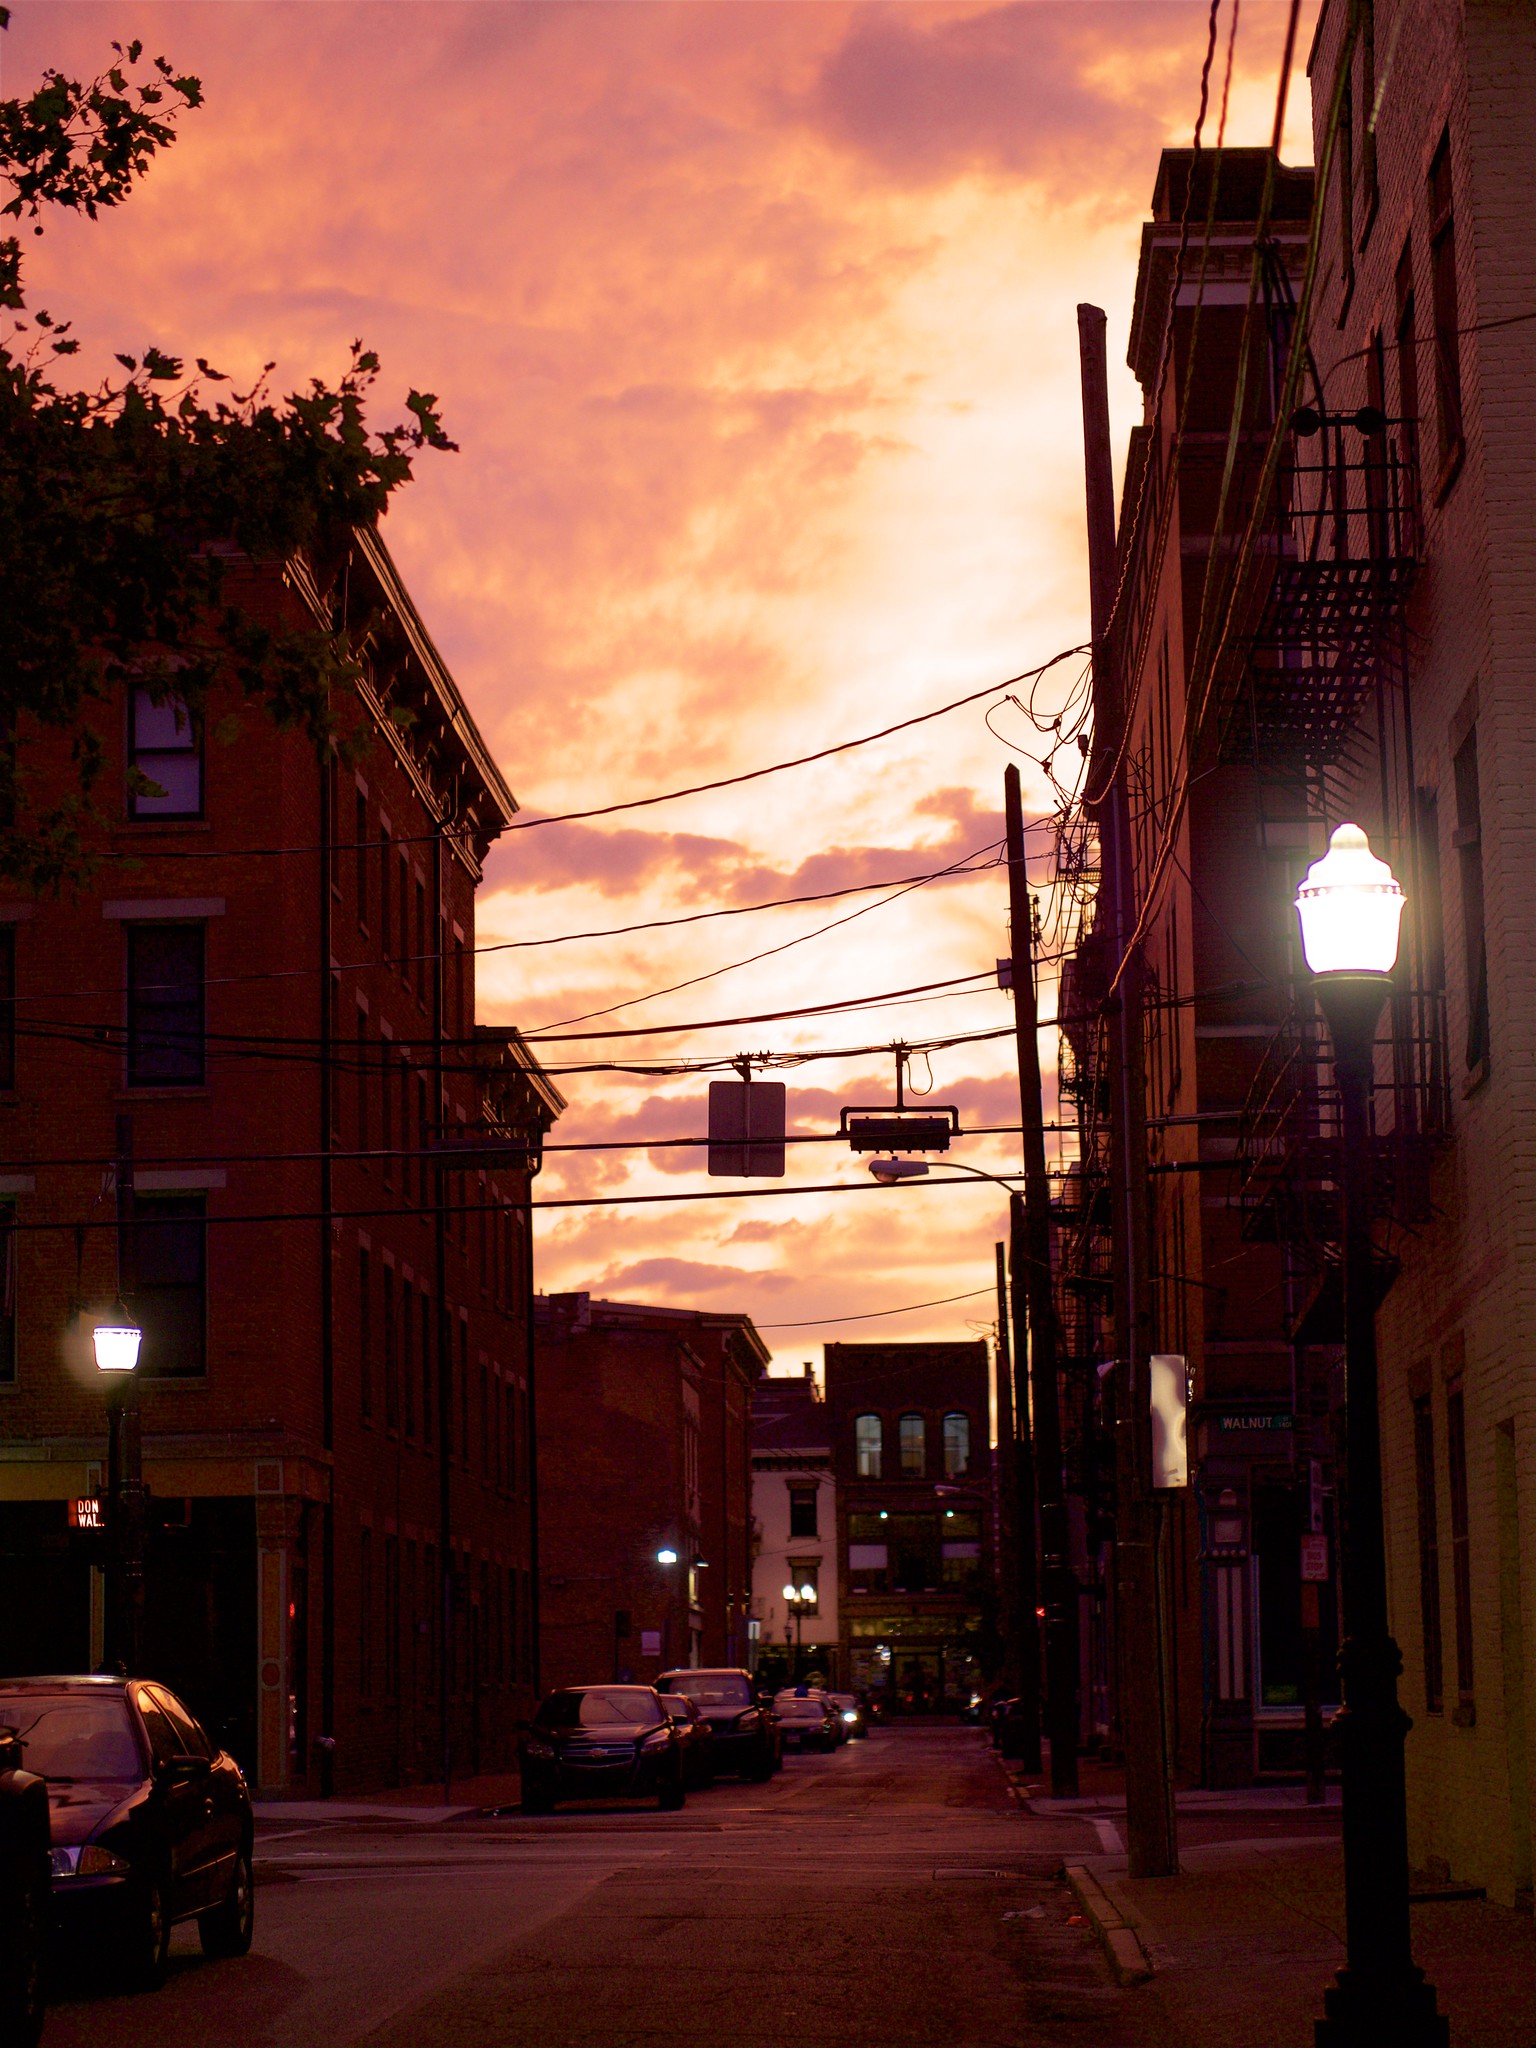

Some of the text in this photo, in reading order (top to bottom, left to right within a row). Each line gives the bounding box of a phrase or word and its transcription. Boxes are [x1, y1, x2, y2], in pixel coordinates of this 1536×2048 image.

[1223, 1417, 1272, 1429] WALNUT
[78, 1500, 99, 1514] DON
[78, 1514, 105, 1527] WAL
[1307, 1551, 1322, 1561] BUS
[1305, 1562, 1324, 1571] STOP
